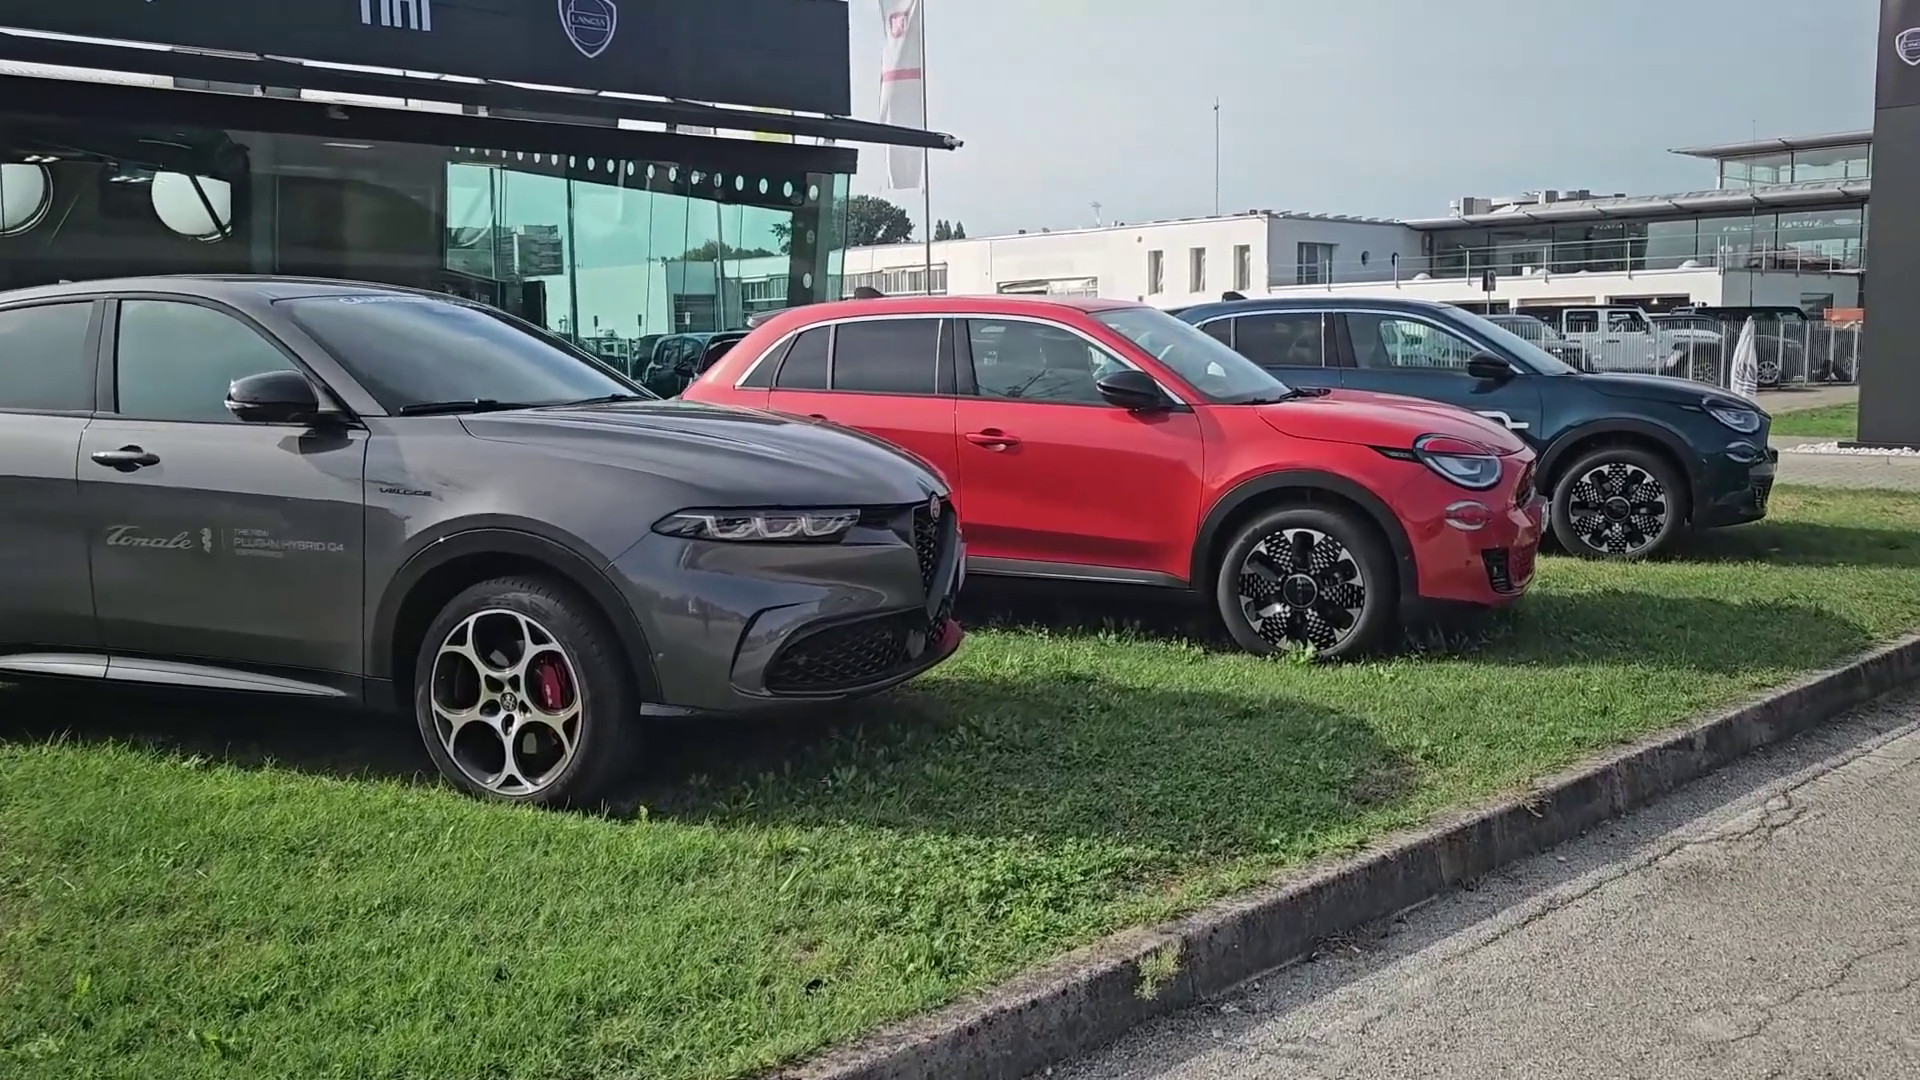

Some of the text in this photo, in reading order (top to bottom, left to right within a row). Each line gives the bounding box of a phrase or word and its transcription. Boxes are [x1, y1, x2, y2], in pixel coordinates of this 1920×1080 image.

[105, 524, 194, 549] Tonale
[281, 540, 325, 551] HYBRID
[327, 542, 344, 552] Q4
